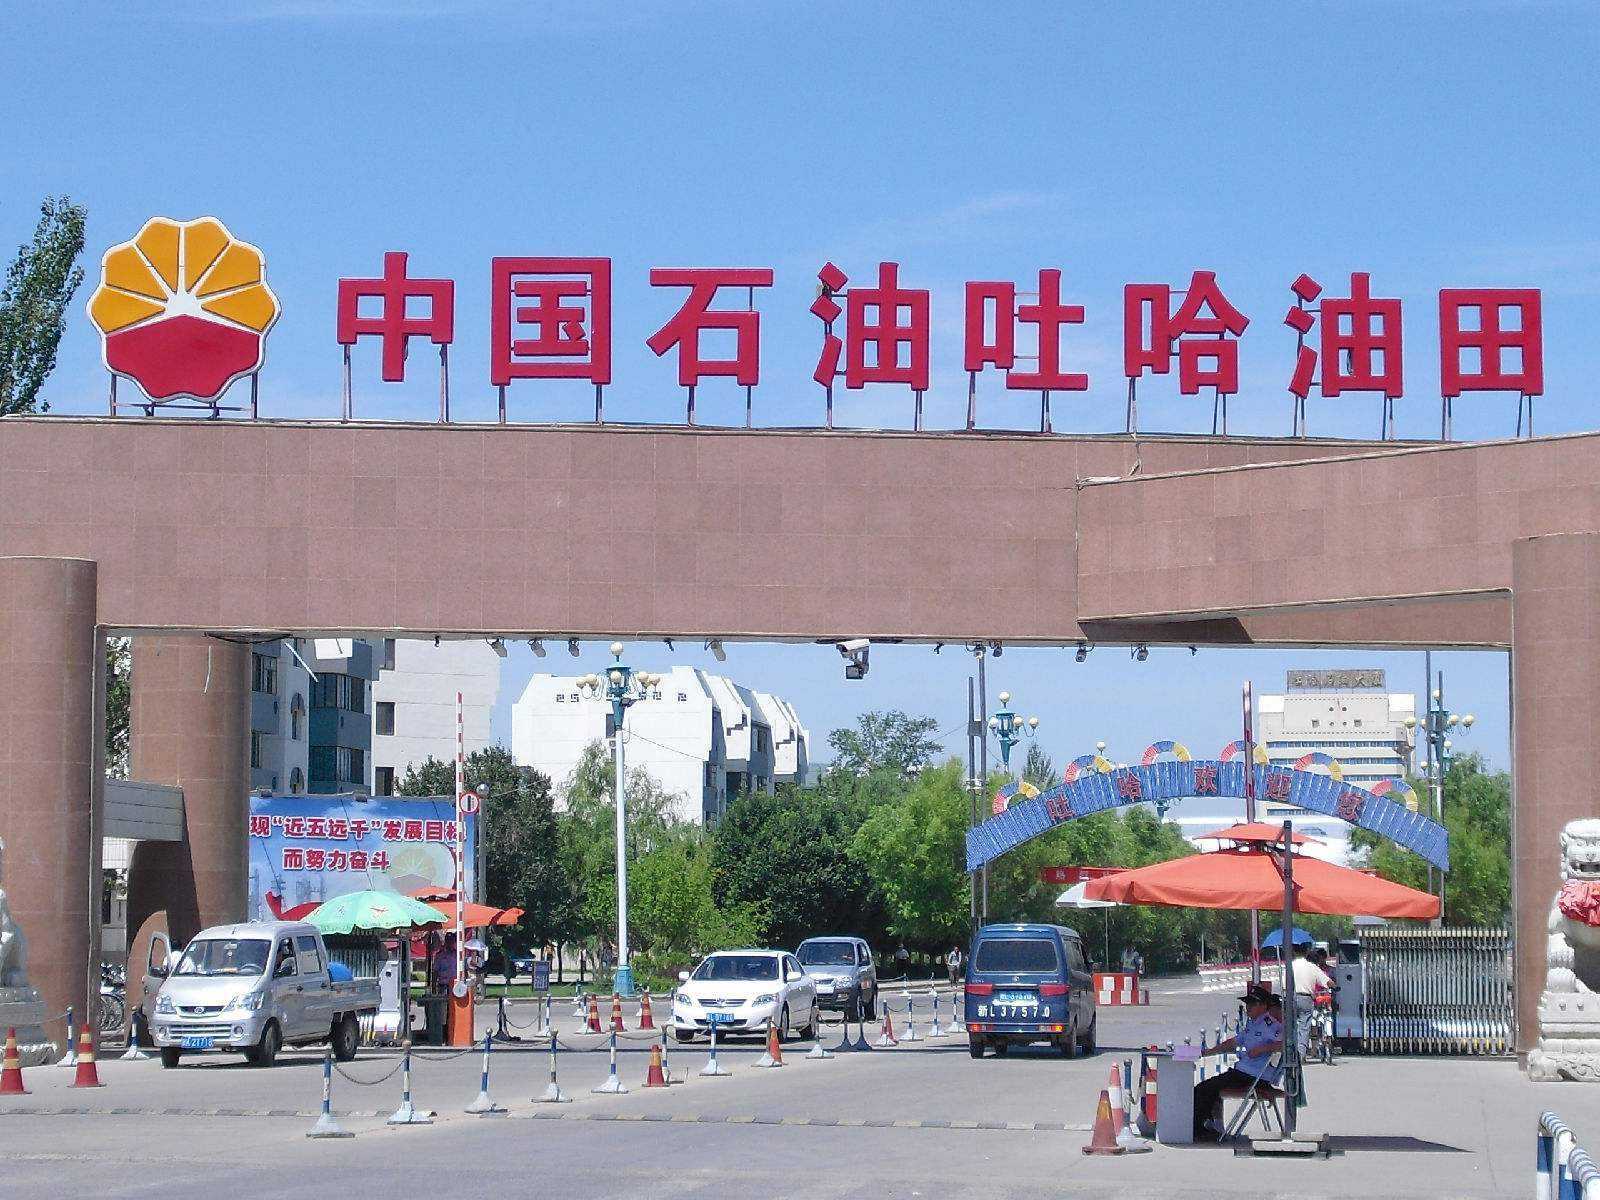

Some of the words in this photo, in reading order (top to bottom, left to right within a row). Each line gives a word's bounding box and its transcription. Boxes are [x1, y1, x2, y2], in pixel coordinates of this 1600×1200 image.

[337, 252, 1545, 397] 中国石油吐哈油田
[283, 848, 391, 871] 而努力奋斗
